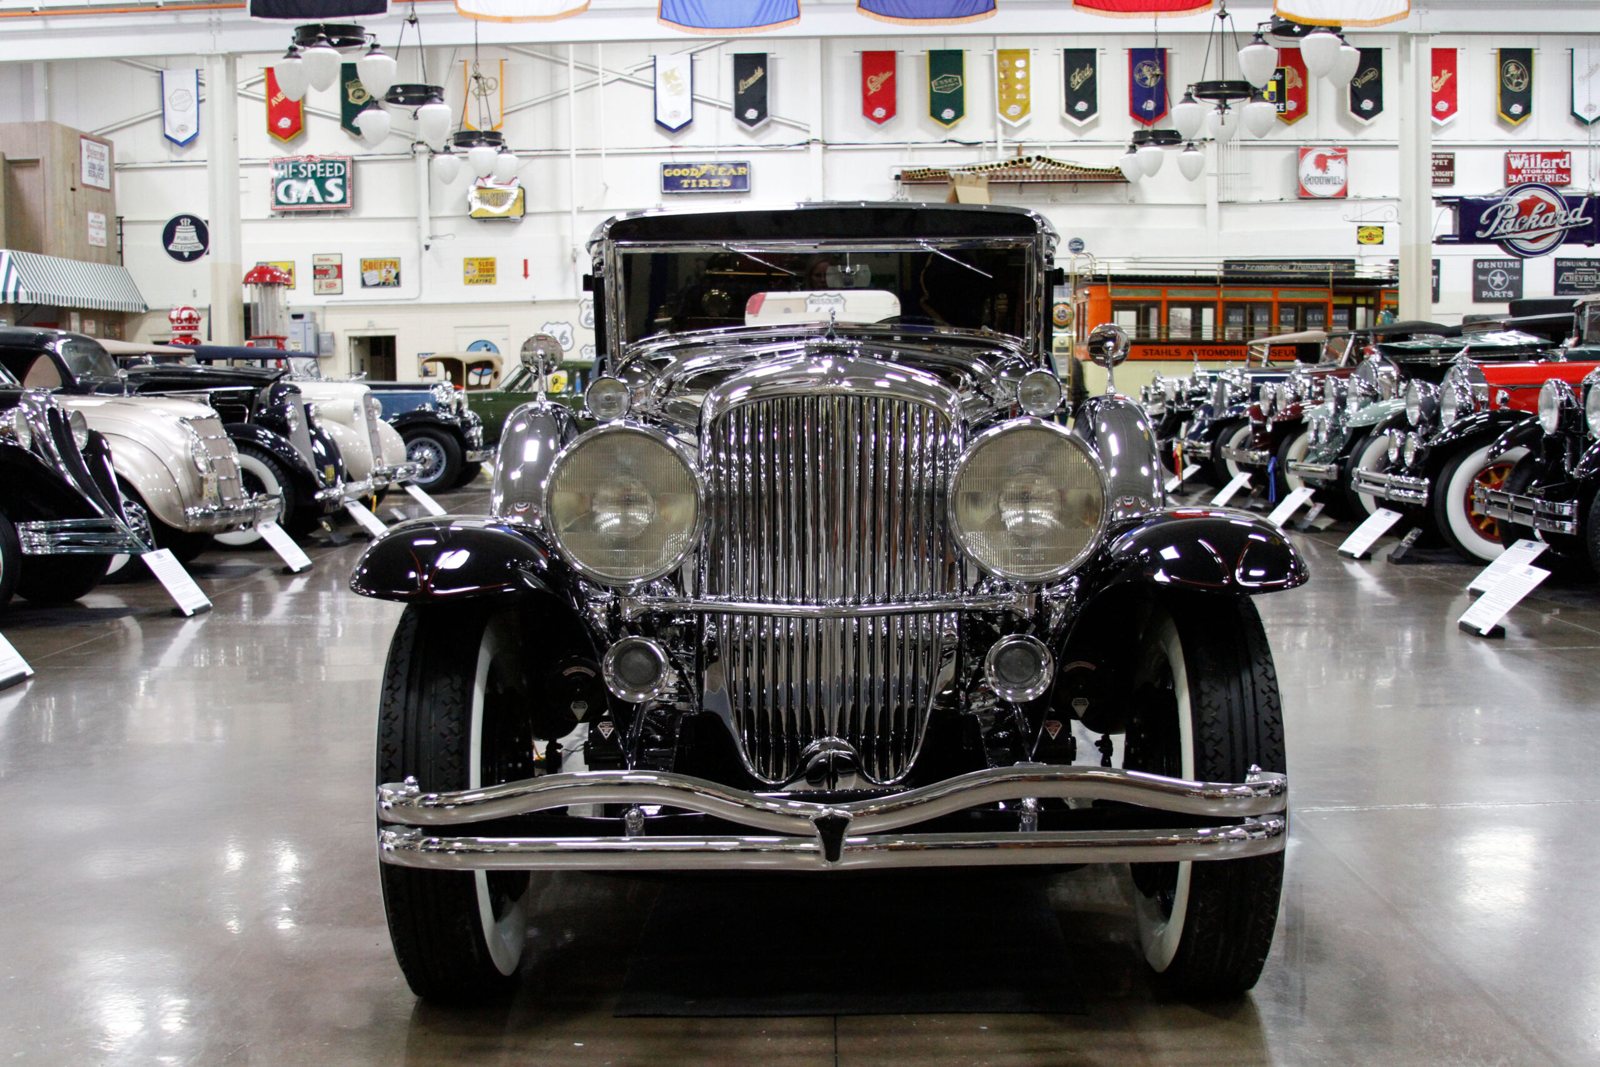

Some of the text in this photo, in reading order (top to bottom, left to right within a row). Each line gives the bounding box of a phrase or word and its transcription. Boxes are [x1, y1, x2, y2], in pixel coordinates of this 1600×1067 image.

[1508, 153, 1570, 169] Willard
[277, 162, 346, 178] HI-SPEED
[680, 178, 732, 188] TIRES
[1508, 173, 1570, 183] BATTERIES
[276, 177, 344, 203] GAS
[1476, 197, 1593, 238] Packard
[1477, 261, 1521, 269] GENUINE
[1563, 274, 1600, 282] CHEVROL
[1142, 349, 1297, 357] STAHLS AUTOMOBIL SEUM
